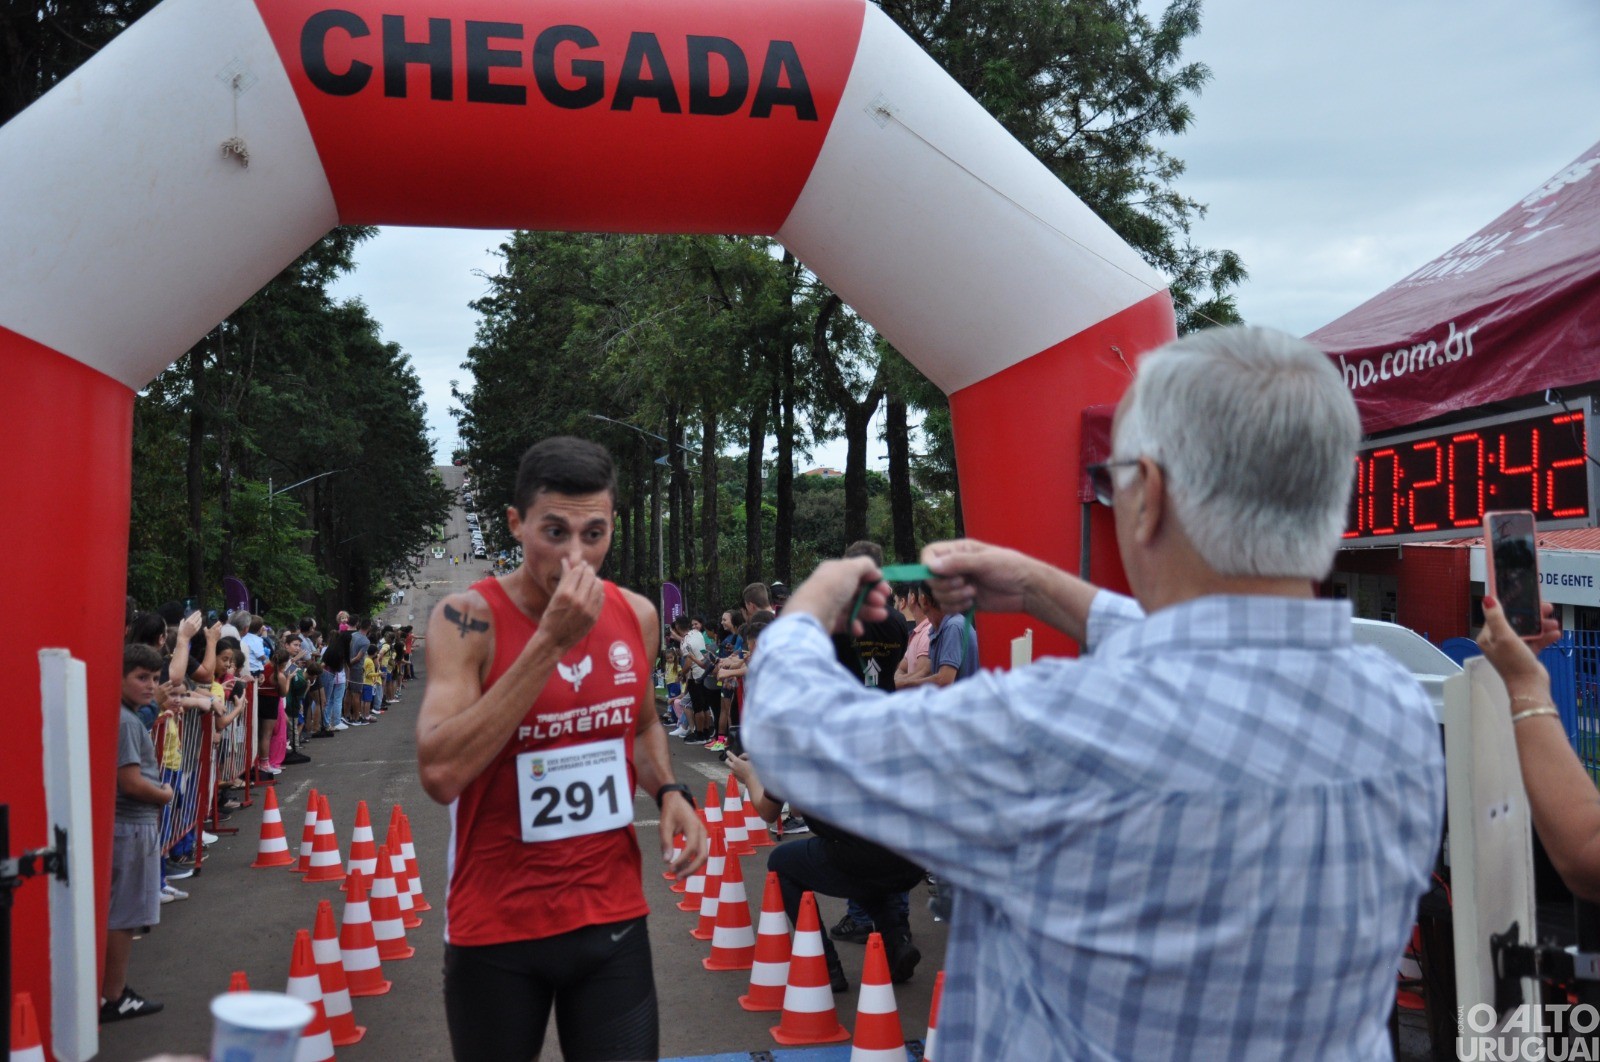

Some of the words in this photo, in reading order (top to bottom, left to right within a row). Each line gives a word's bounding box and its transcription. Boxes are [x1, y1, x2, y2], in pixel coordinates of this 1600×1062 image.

[301, 9, 818, 121] CHEGADA
[1546, 573, 1558, 585] DE
[1561, 574, 1593, 587] GENTE
[531, 775, 620, 828] 291
